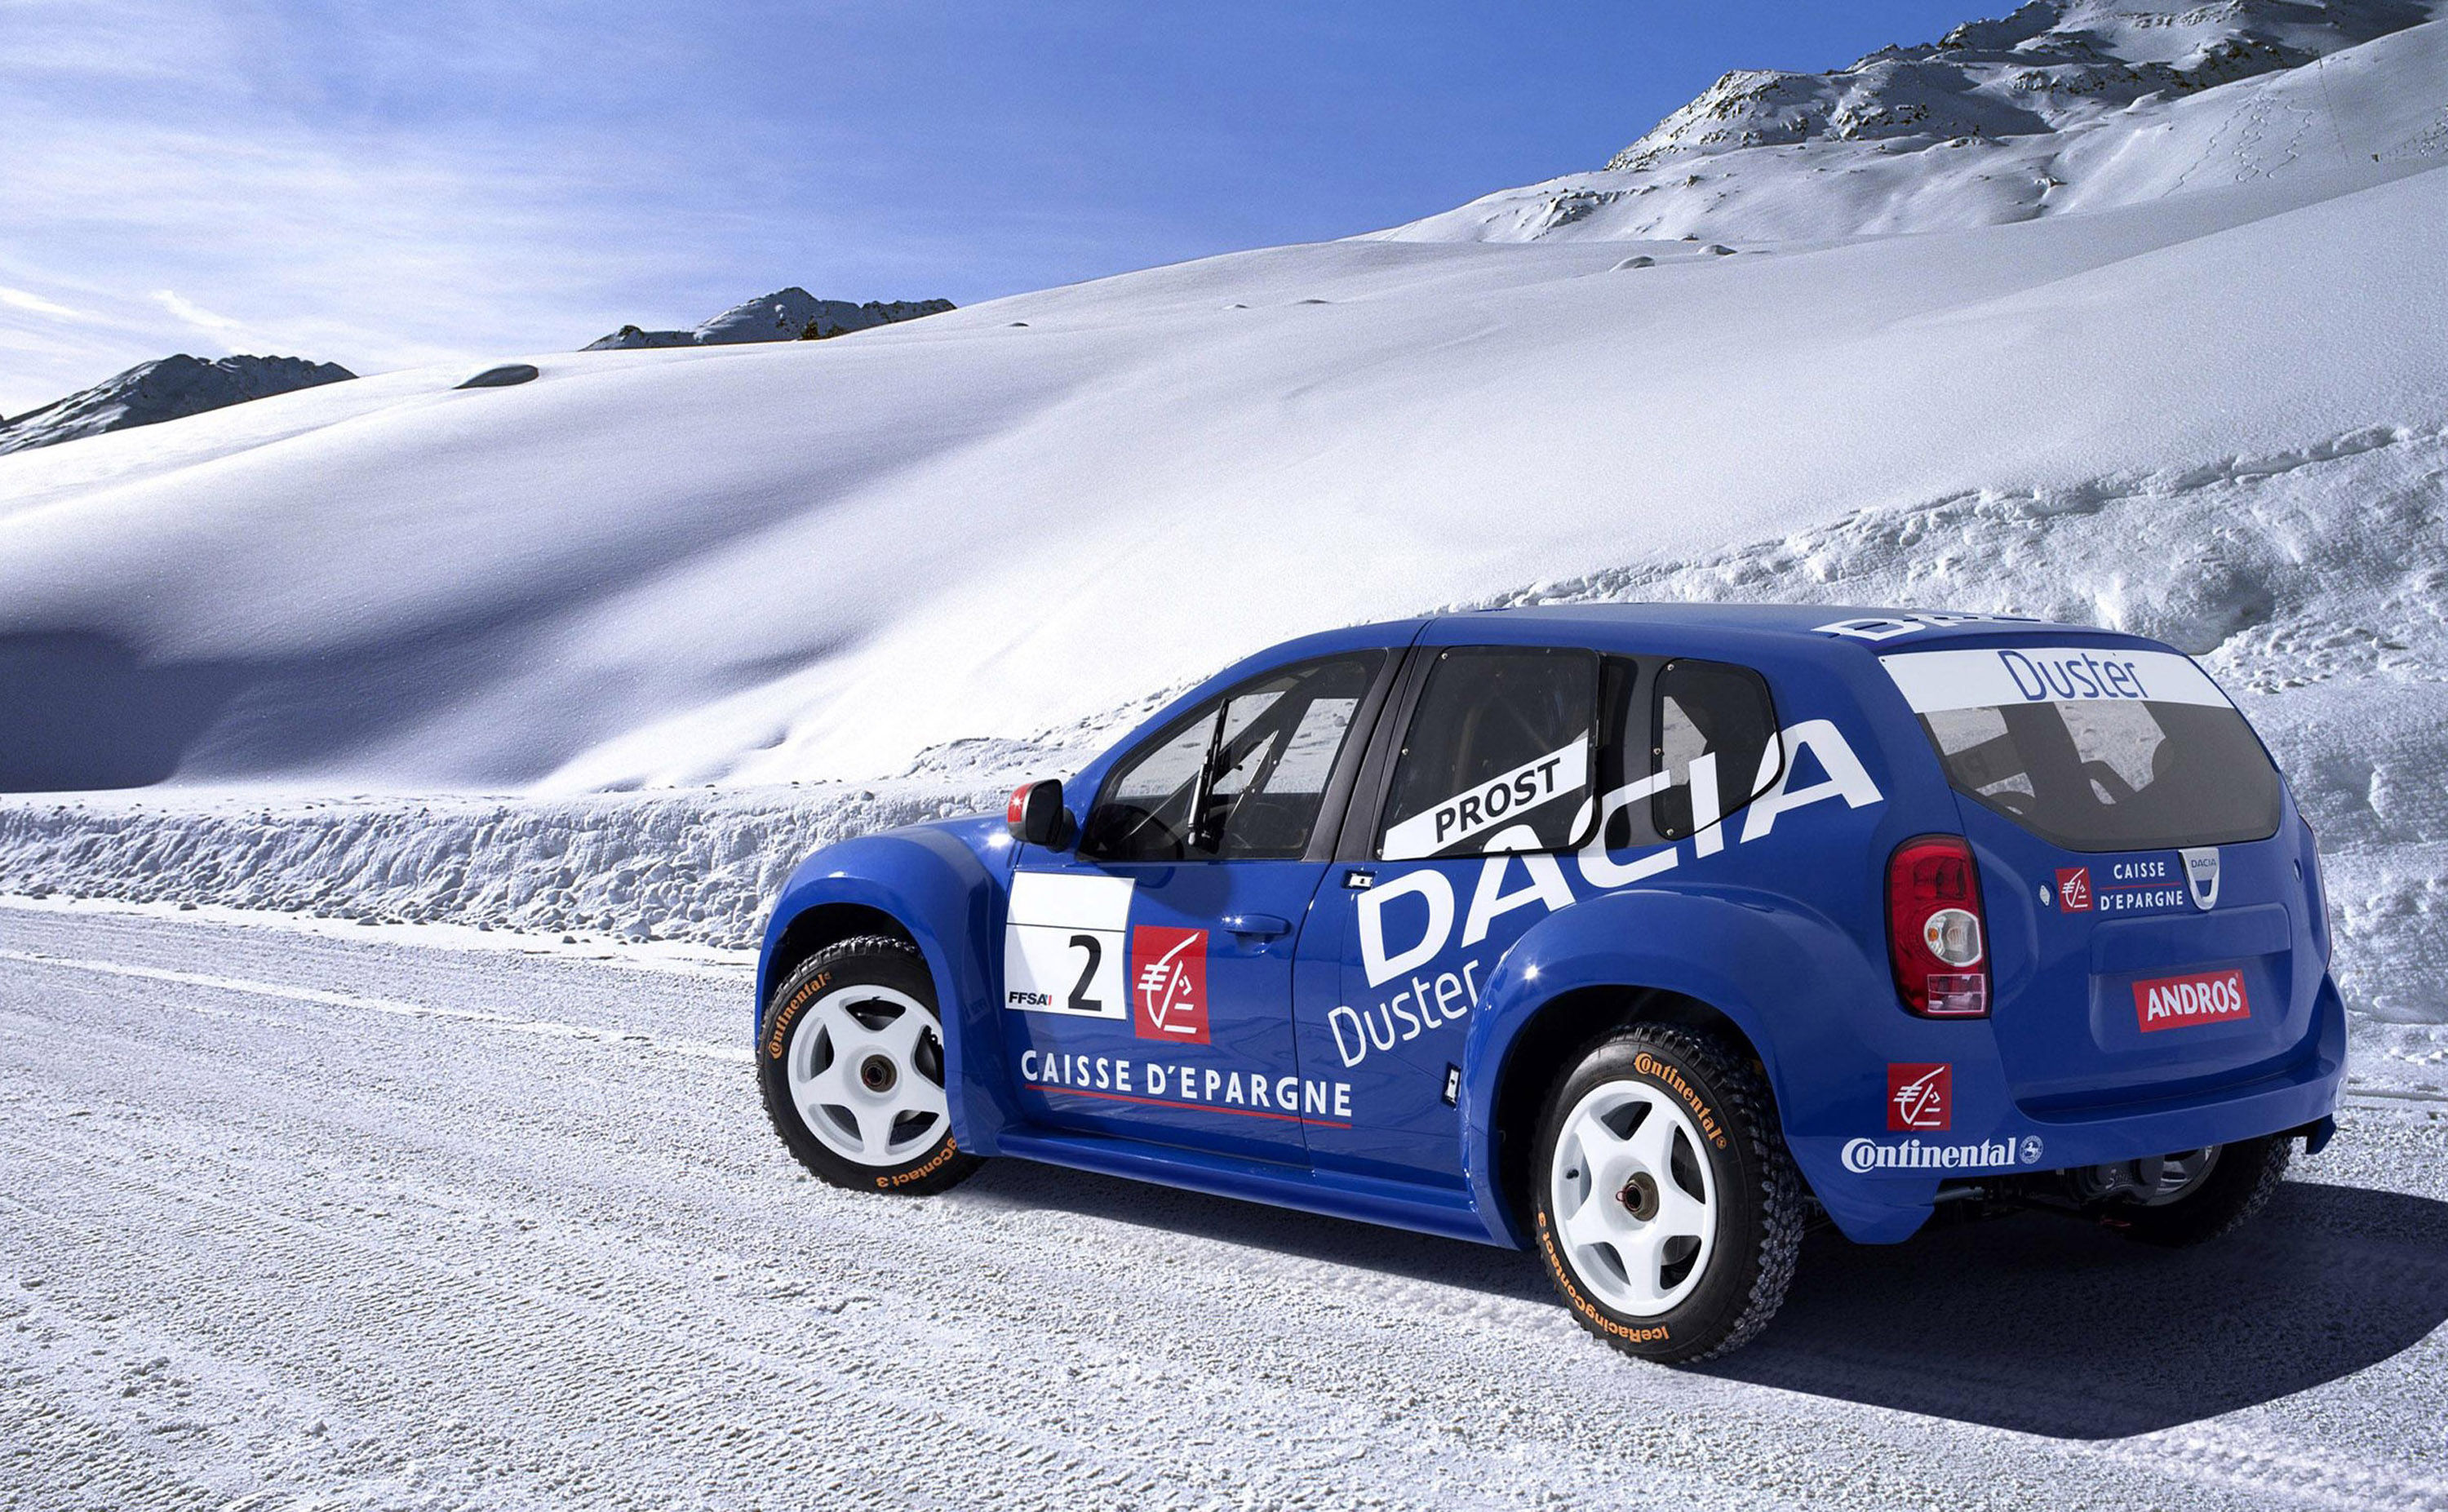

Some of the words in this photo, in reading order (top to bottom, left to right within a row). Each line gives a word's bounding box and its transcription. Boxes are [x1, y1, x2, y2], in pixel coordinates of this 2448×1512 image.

[1998, 650, 2149, 701] Duster
[1435, 757, 1560, 844] PROST
[1356, 719, 1884, 988] DACIA
[2113, 862, 2165, 880] CAISSE
[2191, 858, 2217, 868] DACIA
[2100, 890, 2184, 911] D'EPARGNE
[1068, 934, 1102, 1012] 2
[1009, 991, 1048, 1006] FFSA
[1328, 960, 1479, 1068] Duster
[2148, 978, 2242, 1022] ANDROS
[1021, 1049, 1132, 1092] CAISSE
[1146, 1063, 1352, 1117] D'EPARGNE
[1841, 1137, 2016, 1173] Continental
[876, 1177, 889, 1188] 3
